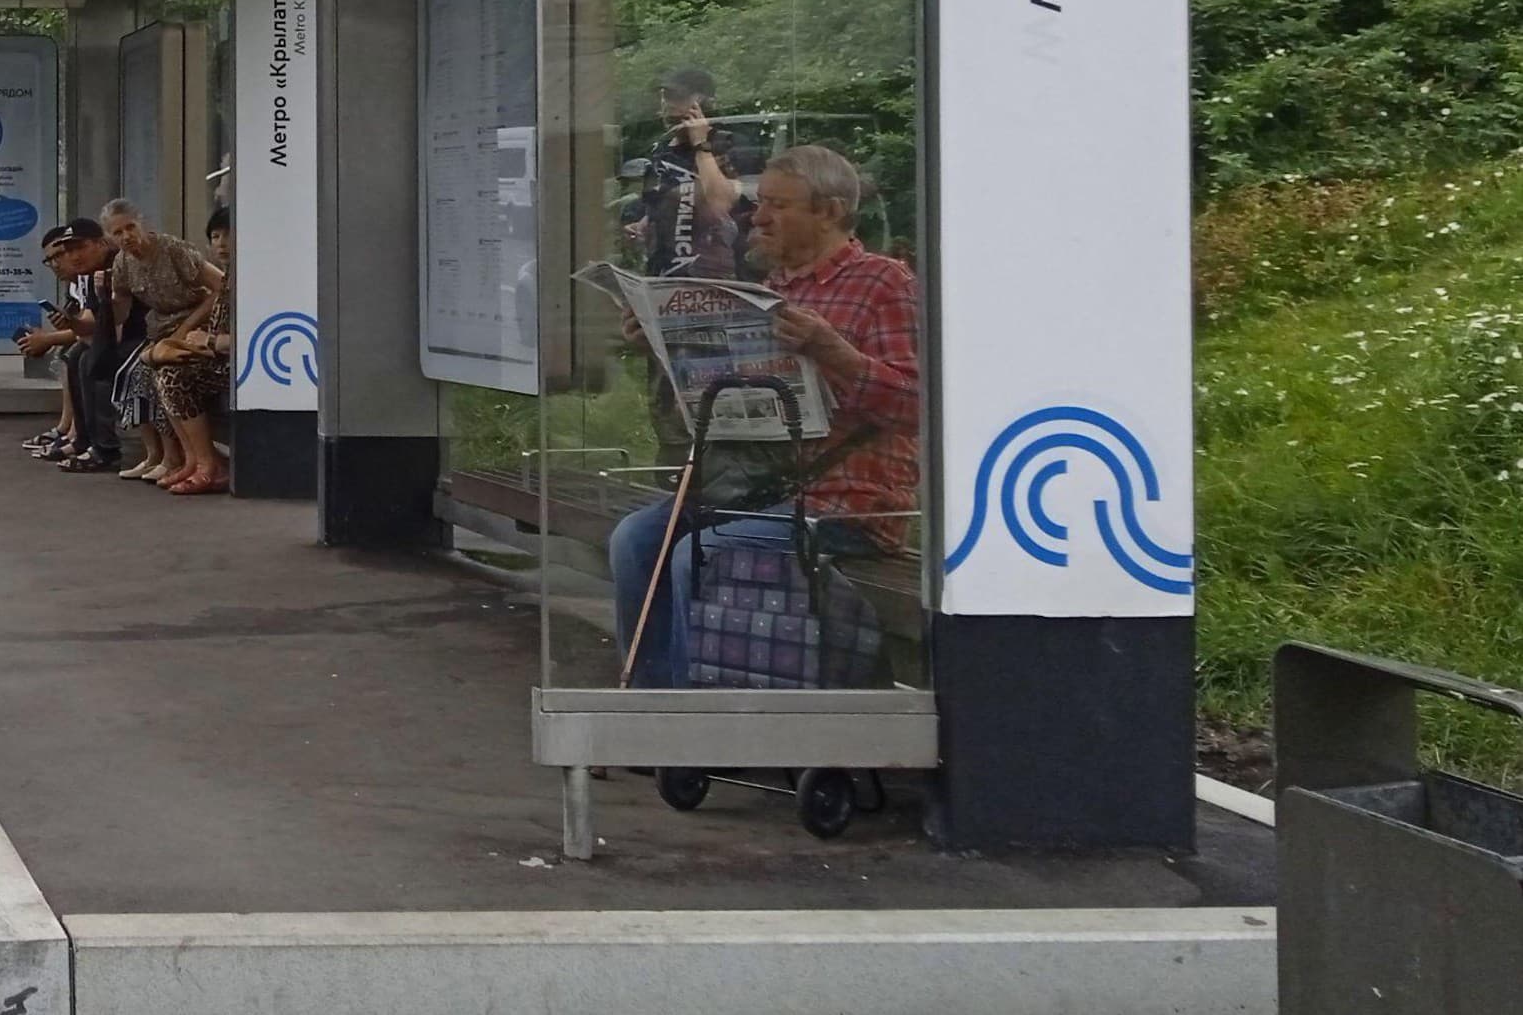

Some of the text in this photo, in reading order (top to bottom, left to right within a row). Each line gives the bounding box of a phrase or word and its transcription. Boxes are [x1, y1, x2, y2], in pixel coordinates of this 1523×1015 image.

[293, 13, 306, 56] Metro
[270, 95, 291, 167] Метро
[660, 160, 701, 276] METALLICA
